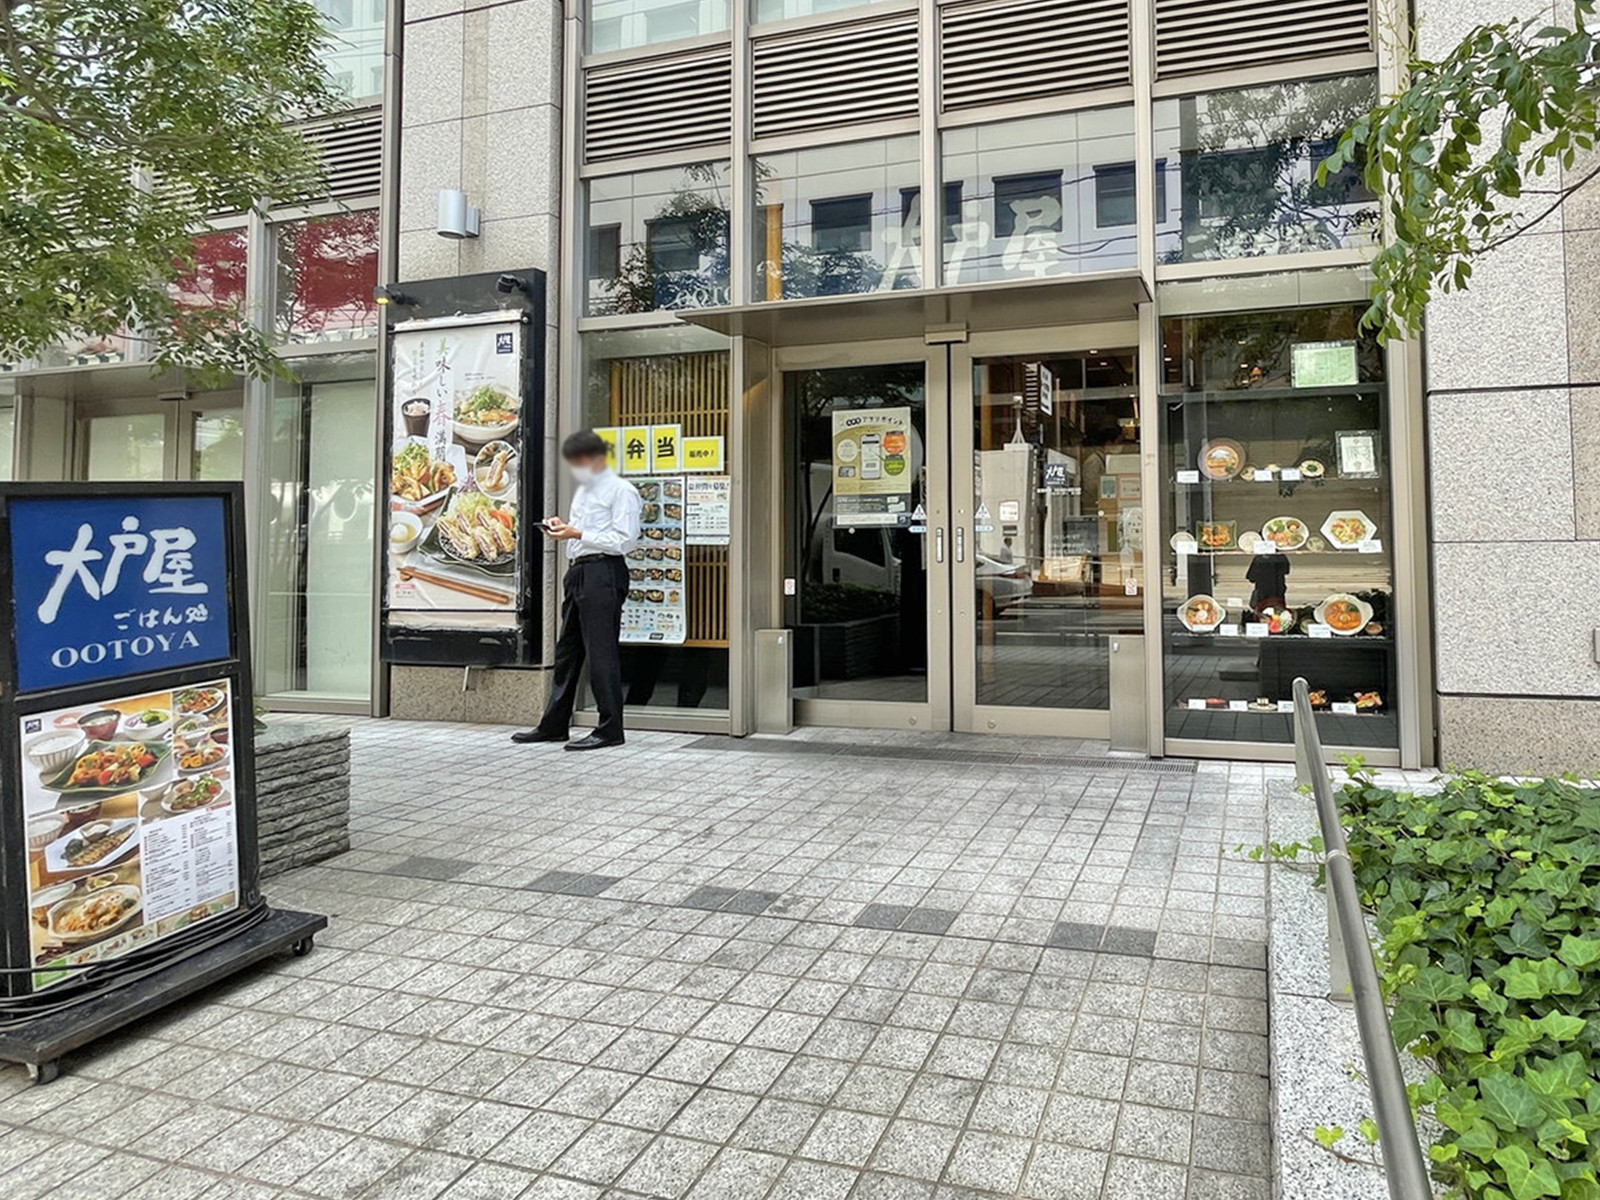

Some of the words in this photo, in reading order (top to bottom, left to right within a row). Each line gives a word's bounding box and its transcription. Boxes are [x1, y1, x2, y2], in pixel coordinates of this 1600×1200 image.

[878, 193, 1069, 291] 大戸屋
[37, 515, 209, 625] 大戸屋
[51, 632, 200, 668] OOTOYA
[113, 603, 209, 630] ごはん処
